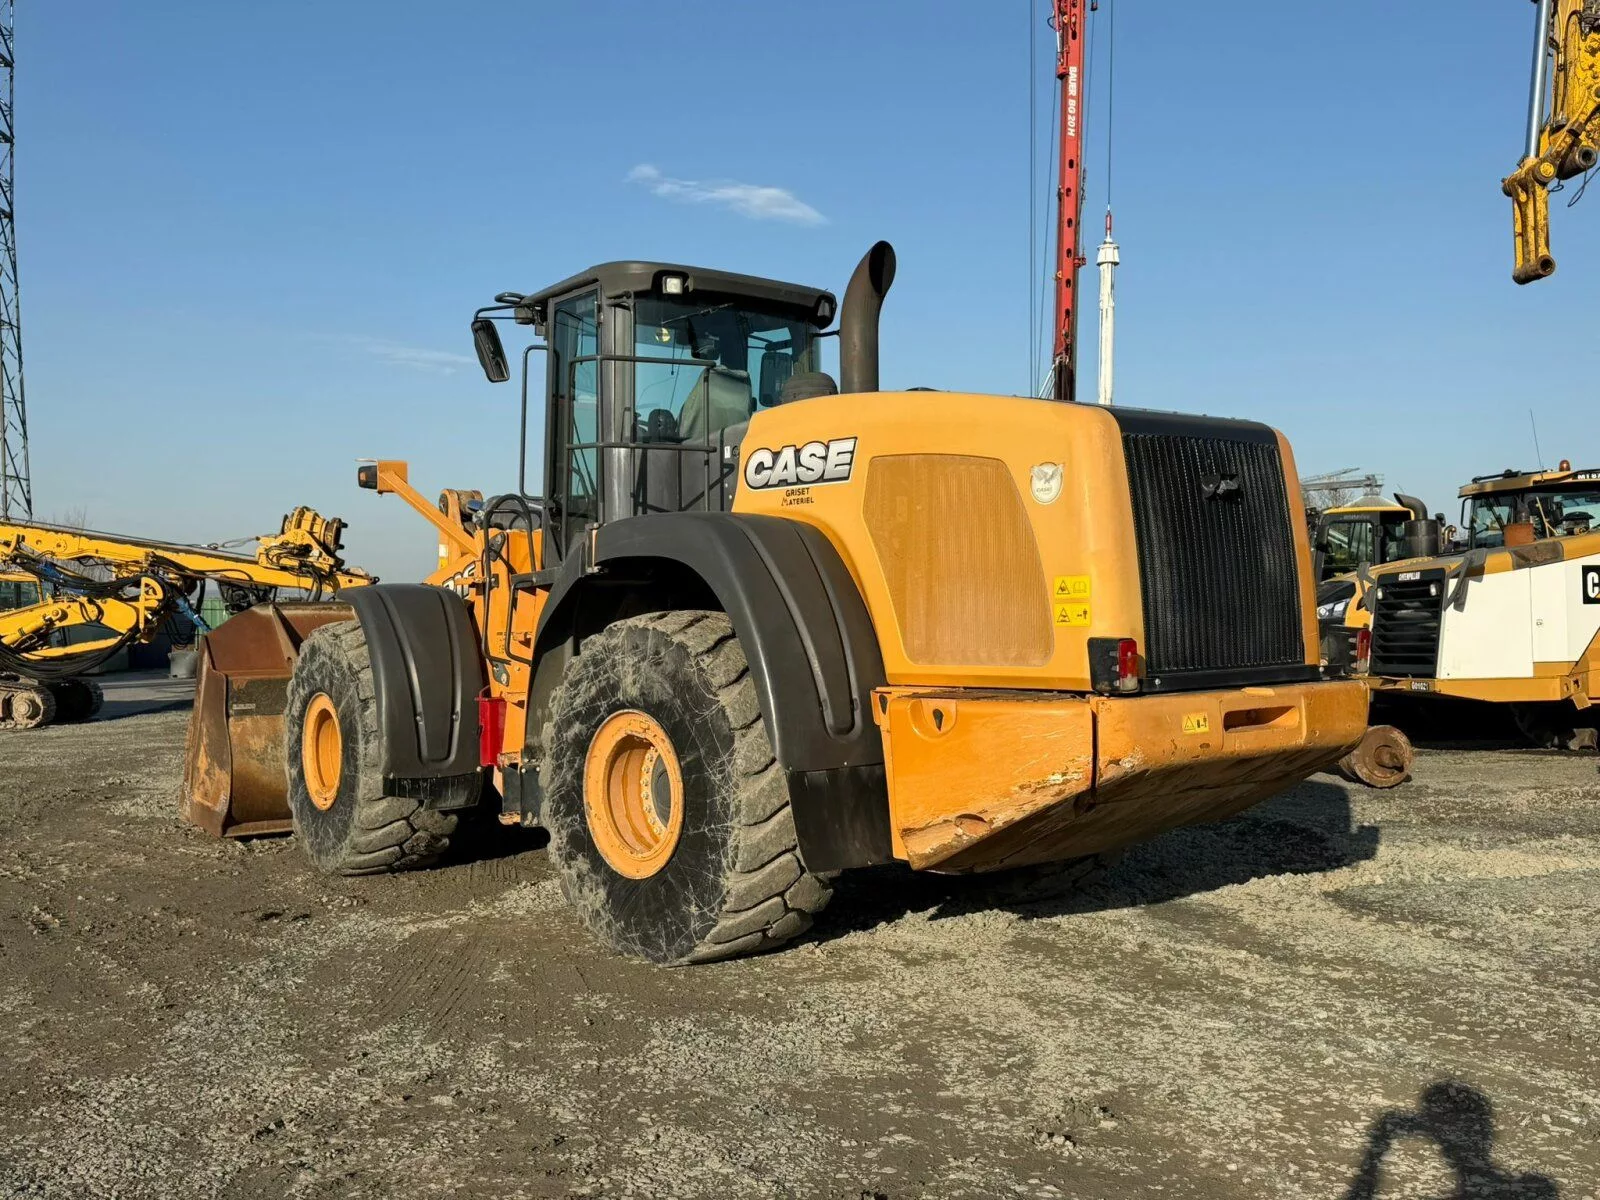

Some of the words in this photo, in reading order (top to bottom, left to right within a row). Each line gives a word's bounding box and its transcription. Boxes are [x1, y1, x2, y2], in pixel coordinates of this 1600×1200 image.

[1068, 66, 1078, 97] BAUER
[1067, 98, 1077, 115] BG
[745, 437, 857, 489] CASE
[785, 487, 810, 498] GRISET
